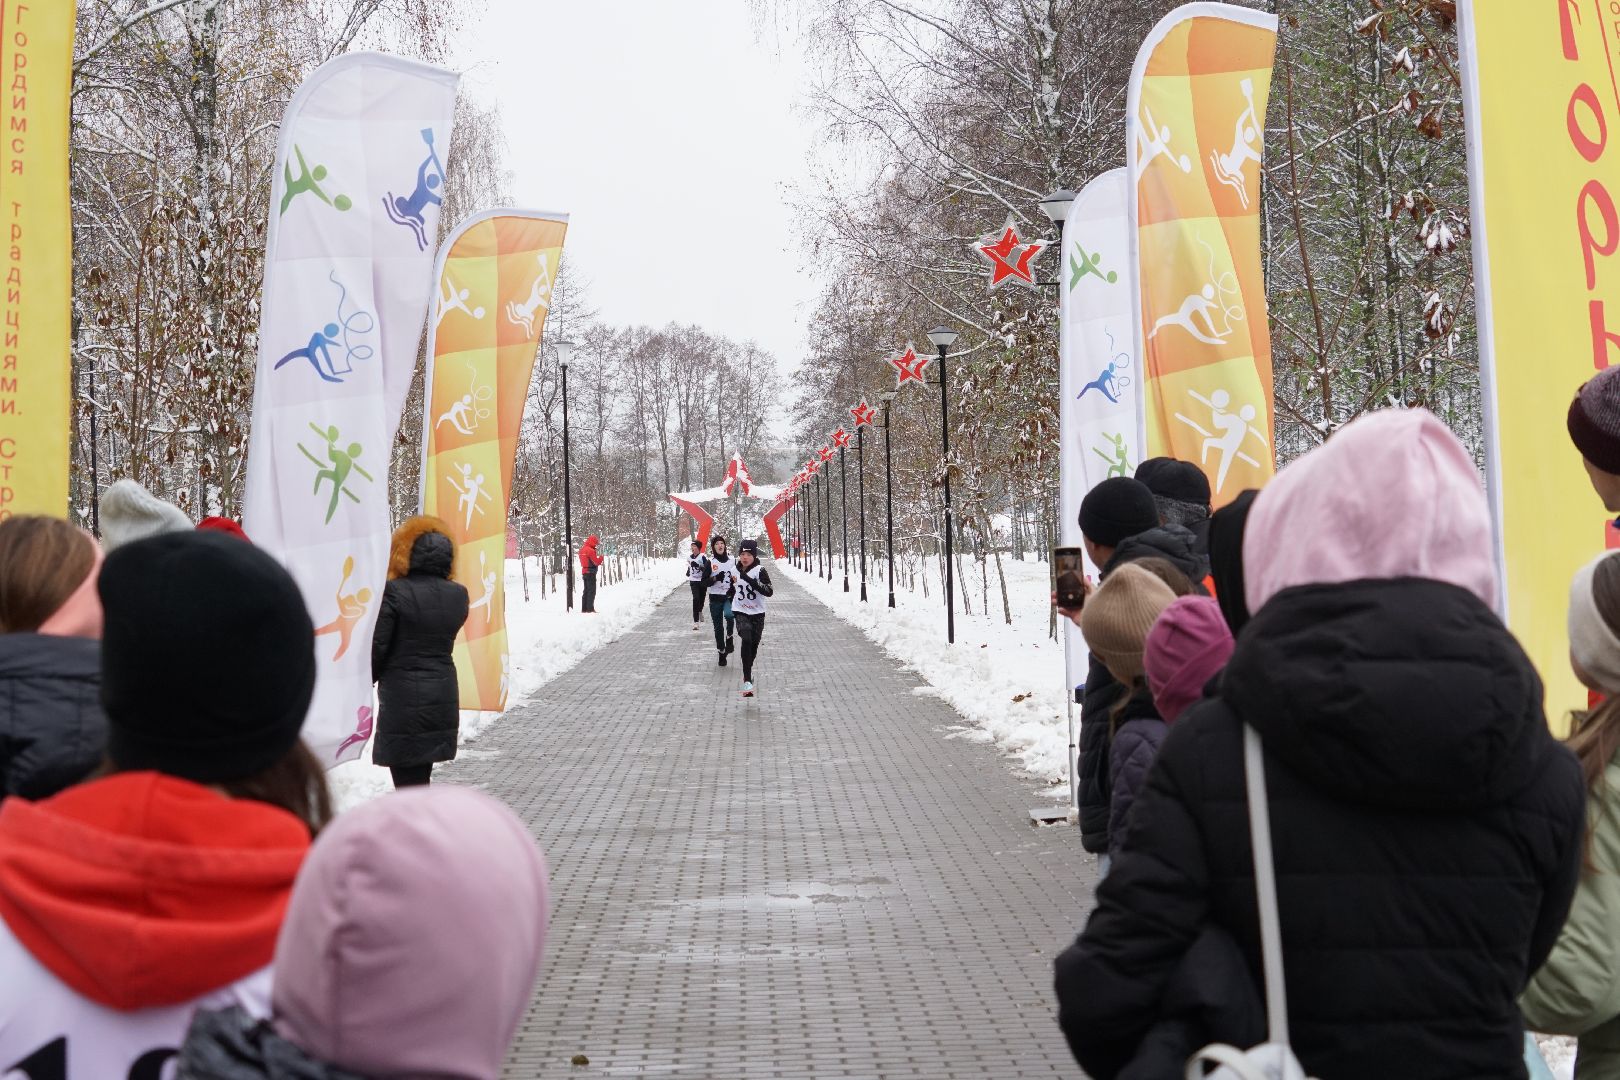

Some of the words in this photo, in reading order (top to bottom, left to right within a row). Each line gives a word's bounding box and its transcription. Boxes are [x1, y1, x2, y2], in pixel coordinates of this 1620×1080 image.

[10, 5, 29, 176] Гордимся
[0, 202, 23, 415] традициями.
[737, 584, 757, 601] 38
